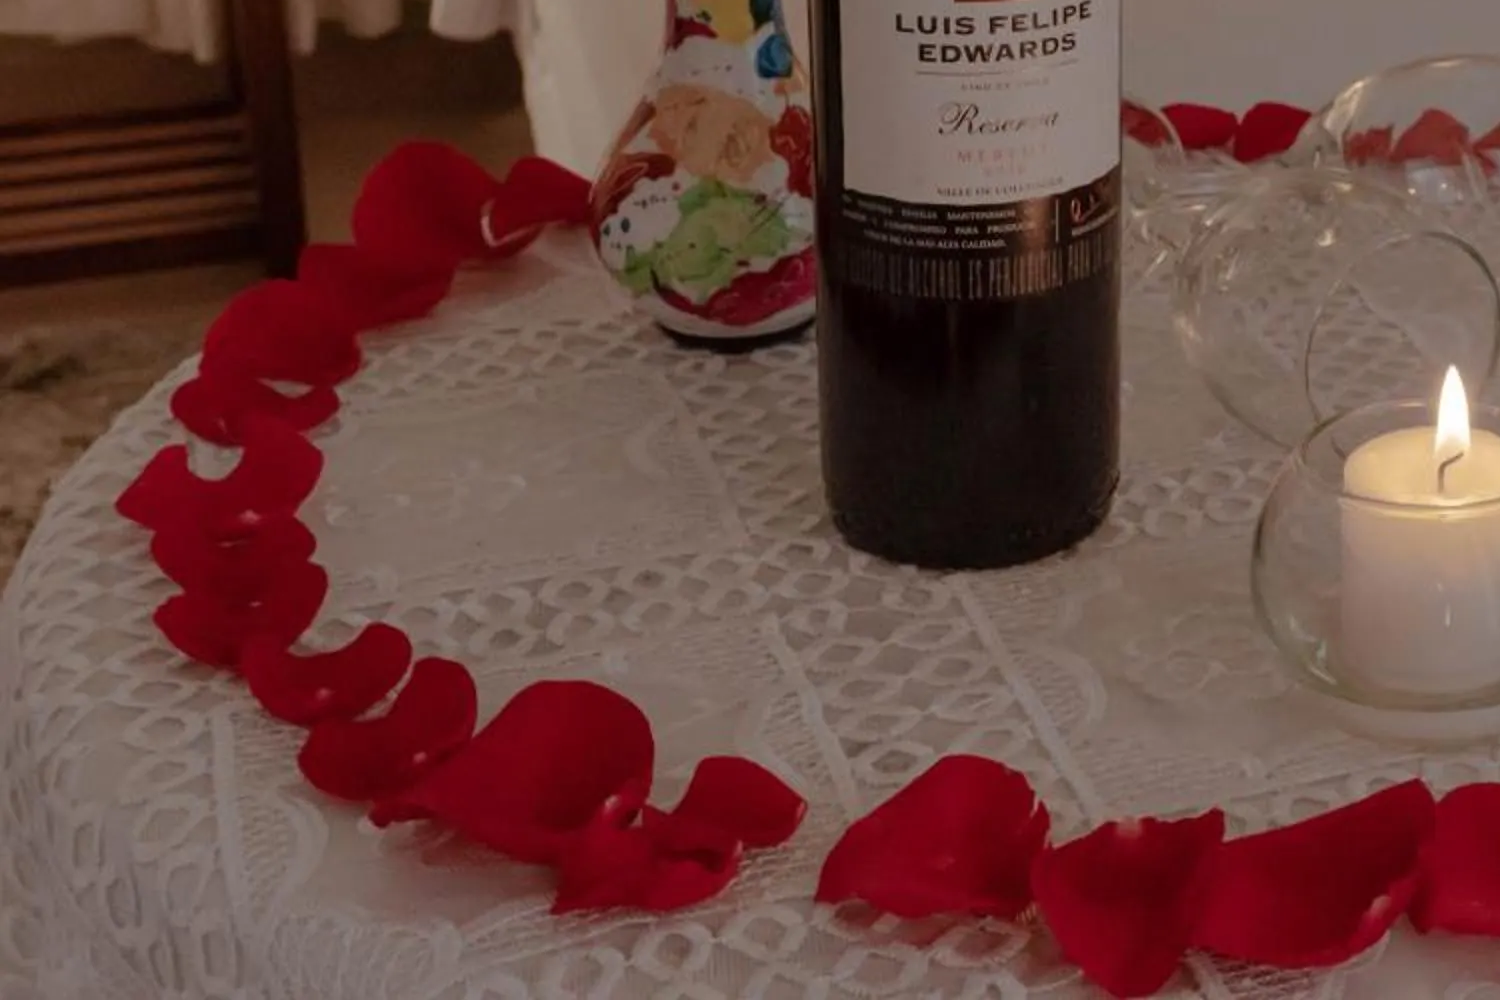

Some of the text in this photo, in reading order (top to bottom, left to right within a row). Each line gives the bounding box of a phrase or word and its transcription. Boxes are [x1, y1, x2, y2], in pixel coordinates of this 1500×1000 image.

[895, 0, 1092, 35] LUIS FELIPE
[918, 32, 1077, 63] EDWARDS
